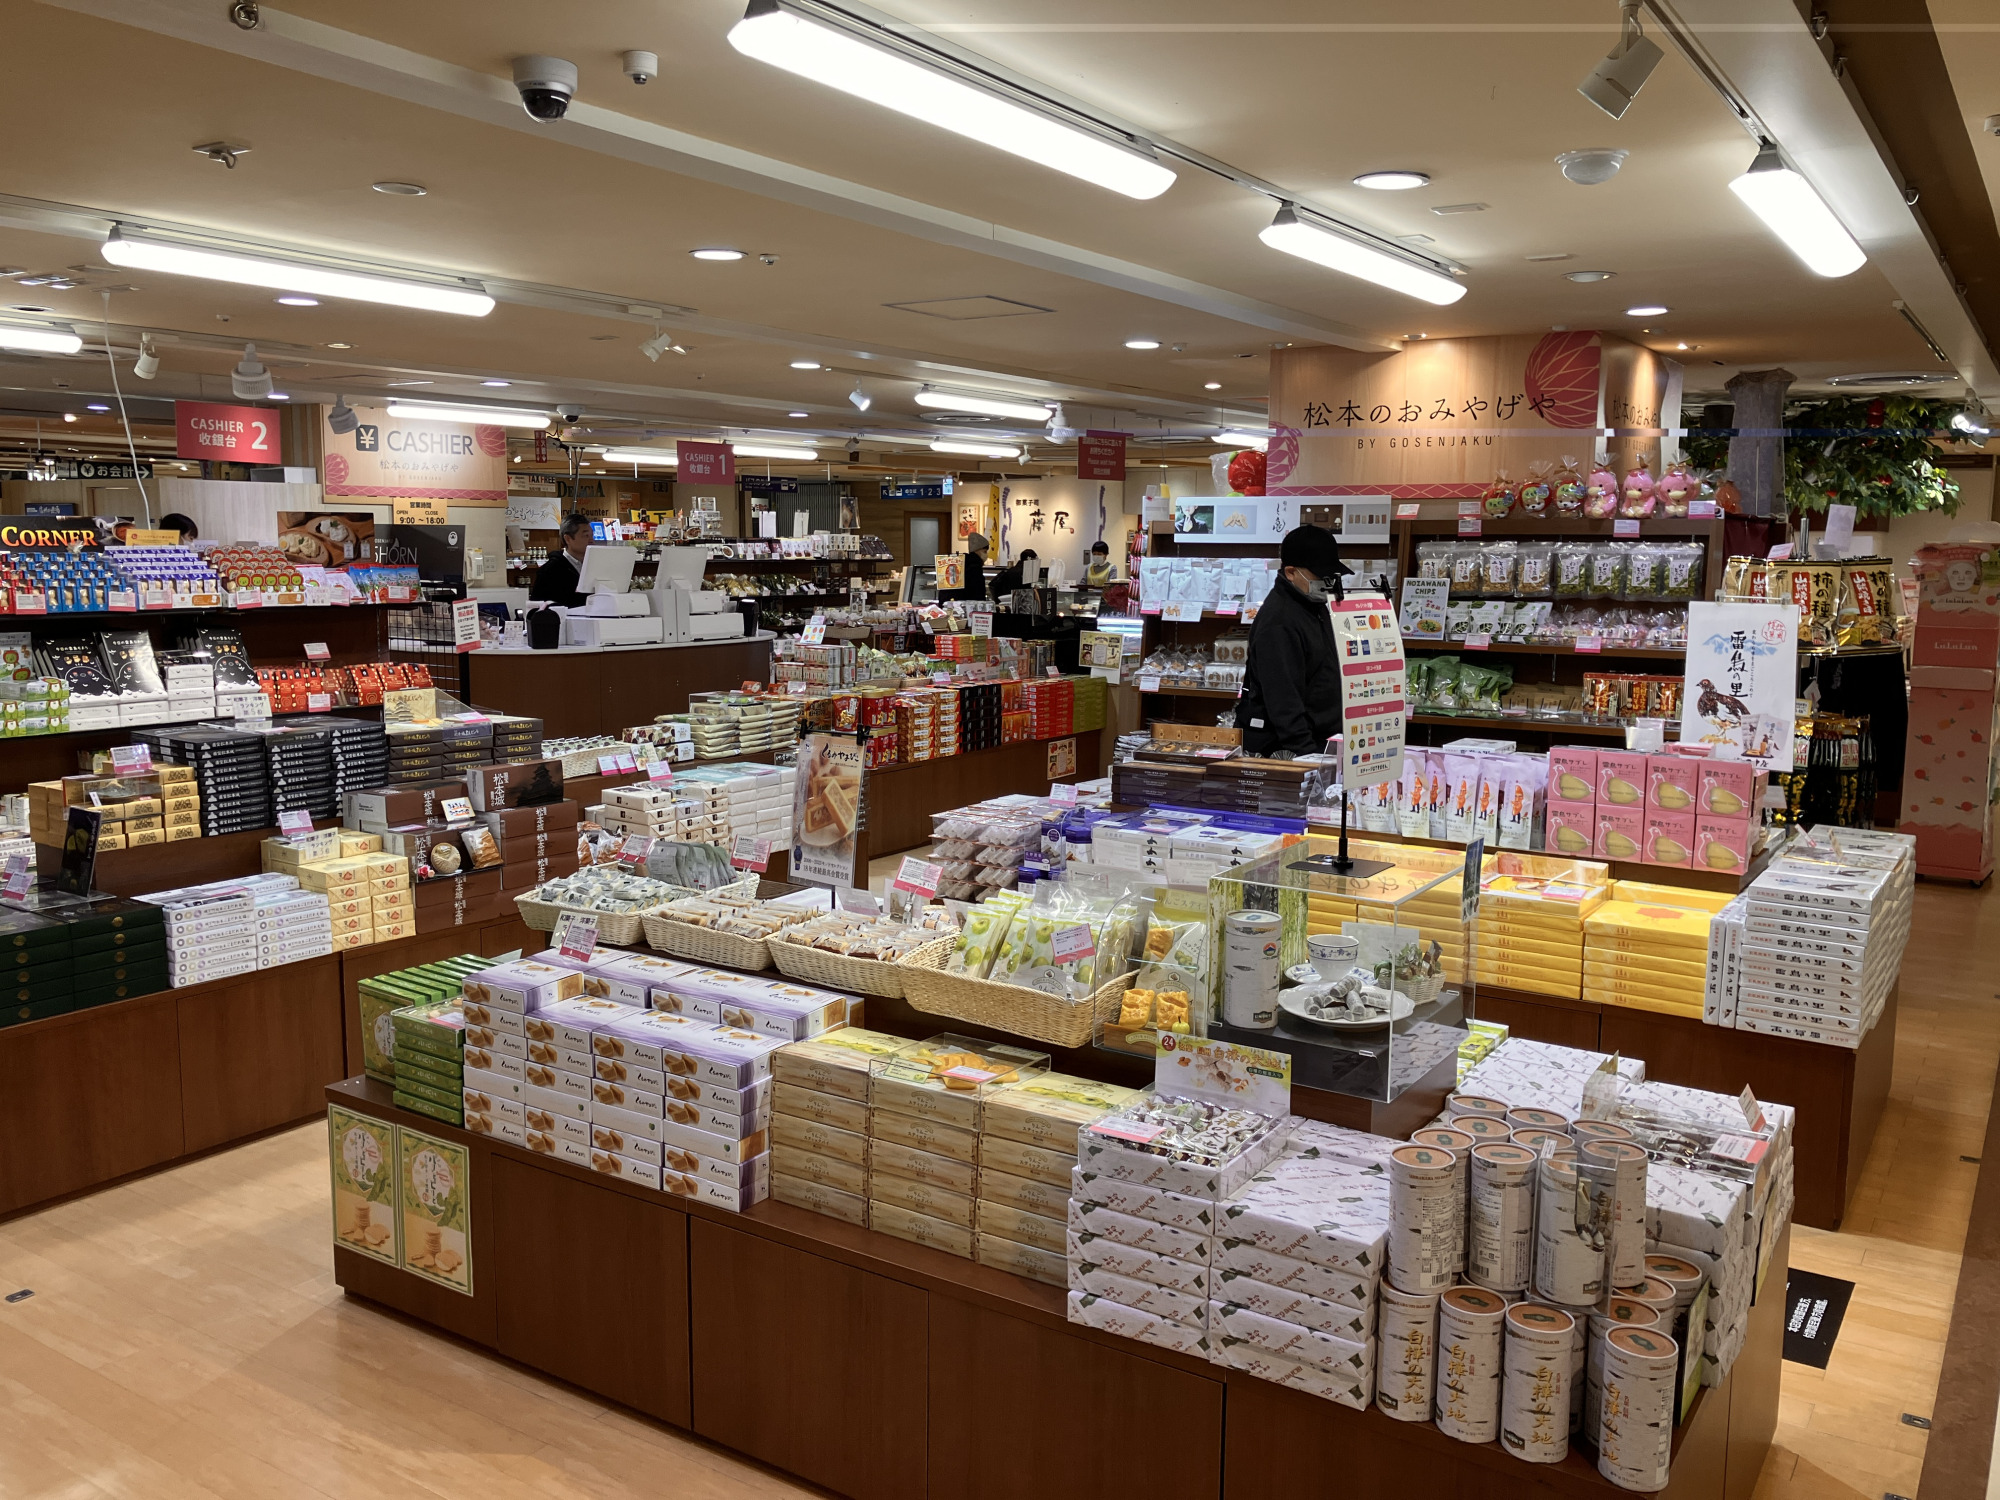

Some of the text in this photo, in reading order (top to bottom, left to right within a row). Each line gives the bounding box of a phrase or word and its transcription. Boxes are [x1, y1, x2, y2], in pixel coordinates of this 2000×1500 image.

[1303, 393, 1556, 428] 松本のおみやげや
[191, 418, 243, 432] CASHIER
[251, 422, 267, 450] 2
[387, 431, 473, 455] CASHIER
[1357, 436, 1494, 450] BY GOSENJAKU
[685, 452, 714, 463] CASHIER
[719, 454, 727, 475] 1
[97, 466, 134, 478] お会計
[380, 460, 459, 473] 松本のおみやげや
[541, 476, 556, 484] FREE
[581, 508, 608, 516] Counter
[1811, 572, 1834, 618] 柿の種
[1869, 570, 1893, 618] 柿の種
[1727, 630, 1749, 698] 雷鳥の里
[821, 743, 859, 762] くるみやまびこ
[1554, 757, 1588, 766] 雷鳥サブレ
[1602, 761, 1637, 770] 雷鳥サブレ
[1652, 765, 1688, 775] 雷鳥サブレ
[1705, 770, 1741, 780] 雷鳥サブレ
[493, 773, 505, 806] 松本城
[1551, 810, 1585, 819] 雷鳥サブレ
[1600, 814, 1635, 824] 雷鳥サブレ
[1650, 819, 1685, 829] 雷鳥サブレ
[1701, 825, 1737, 835] 雷鳥サブレ
[1164, 1037, 1174, 1046] 24
[1214, 1045, 1281, 1070] 白樺の大地
[1404, 1328, 1425, 1404] 白樺の大地
[1447, 1344, 1468, 1423] 白樺の大地
[1531, 1365, 1554, 1445] 白樺の大地
[1602, 1382, 1620, 1466] 白樺の大地
